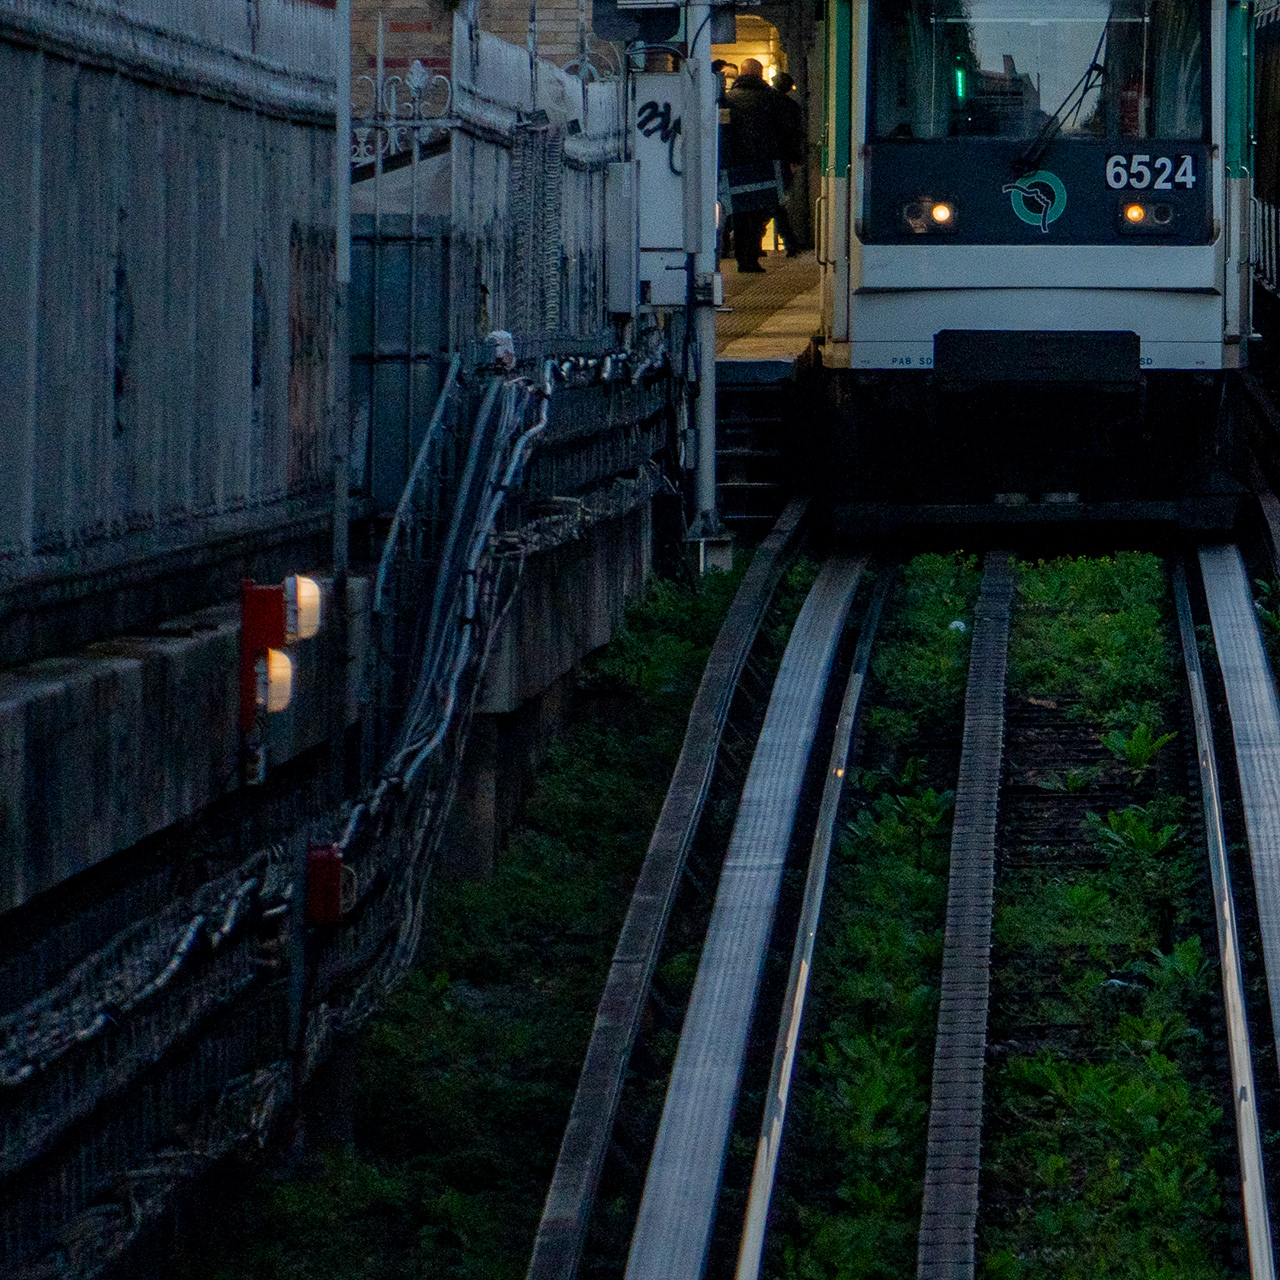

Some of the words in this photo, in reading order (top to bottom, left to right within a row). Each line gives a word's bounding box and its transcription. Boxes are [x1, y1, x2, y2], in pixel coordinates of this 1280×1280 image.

[1106, 154, 1197, 189] 6524
[892, 357, 912, 365] PAB
[919, 357, 933, 365] SD
[1139, 357, 1153, 366] SD
